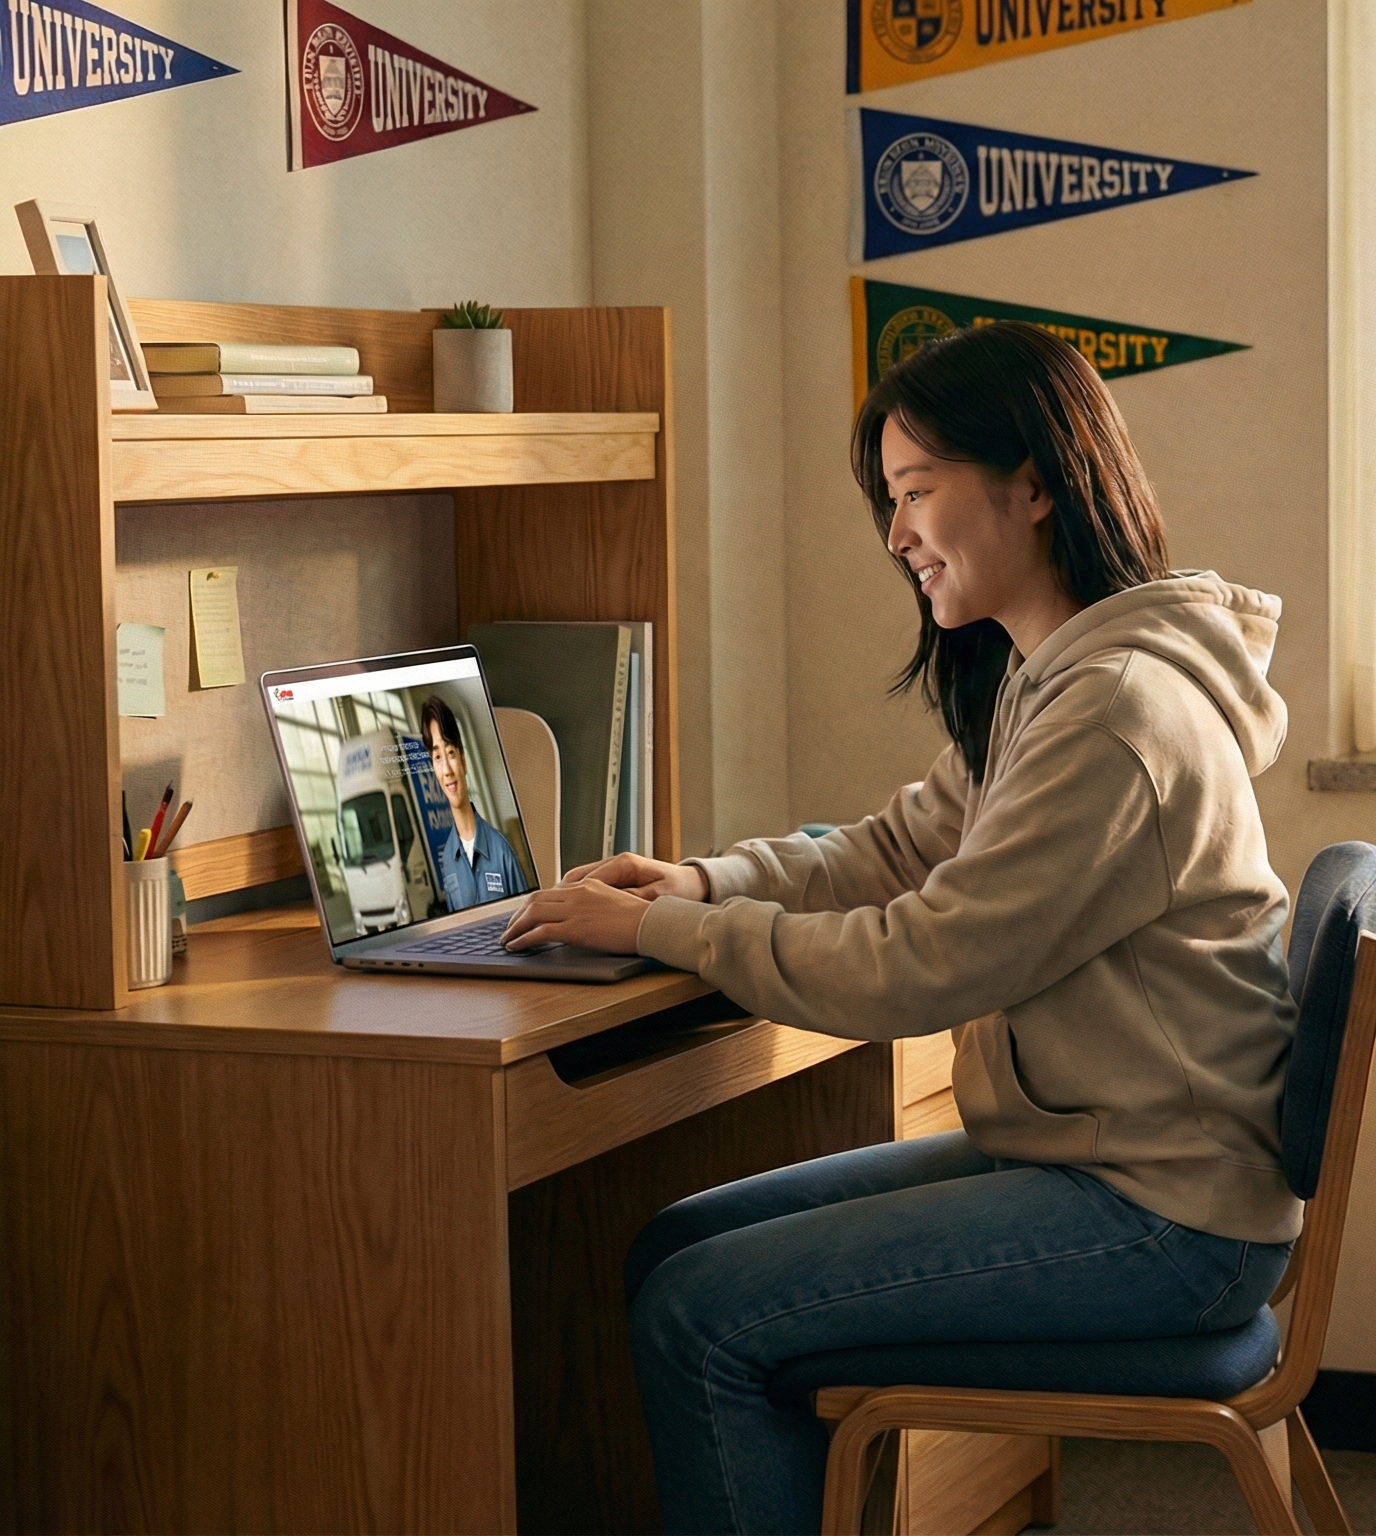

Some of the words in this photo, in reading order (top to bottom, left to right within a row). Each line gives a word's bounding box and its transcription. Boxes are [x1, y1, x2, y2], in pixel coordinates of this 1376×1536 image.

[8, 0, 174, 95] UNIVERSITY
[368, 44, 488, 133] UNIVERSITY
[977, 146, 1175, 217] UNIVERSITY
[973, 316, 1169, 371] RSITY
